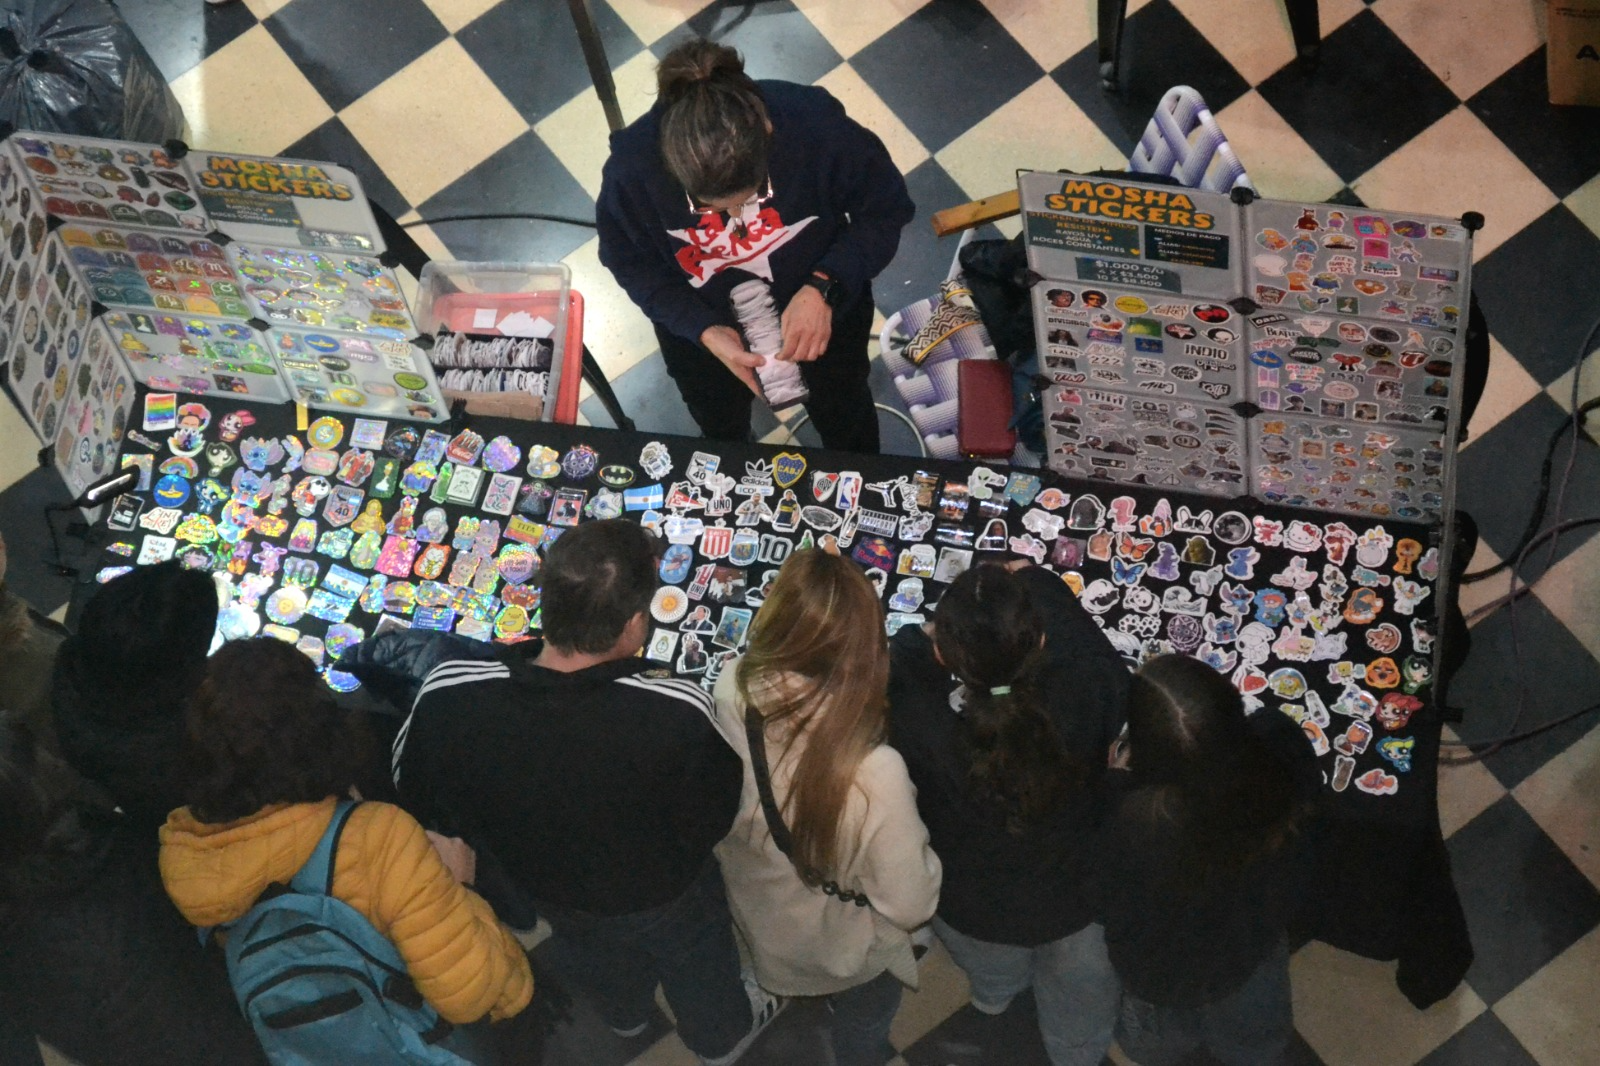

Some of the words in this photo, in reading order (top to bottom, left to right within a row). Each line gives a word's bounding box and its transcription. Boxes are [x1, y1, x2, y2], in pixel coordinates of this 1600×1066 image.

[211, 158, 328, 181] MOSHA
[201, 171, 353, 200] STICKERS
[1065, 180, 1192, 208] MOSHA
[1047, 194, 1214, 228] STICKERS
[1055, 229, 1086, 237] RAYOS
[1065, 235, 1091, 243] AGUA
[1154, 228, 1185, 236] MEDIOS
[1198, 233, 1222, 241] PAGO
[1033, 236, 1064, 245] ROCES
[1066, 239, 1125, 253] CONSTANTES
[1095, 260, 1139, 272] $1.000
[1142, 263, 1164, 275] c/u
[1119, 270, 1159, 281] $3.500
[1122, 276, 1162, 287] $8.500
[1256, 313, 1287, 324] oasis
[1185, 344, 1228, 361] INDIO
[693, 470, 706, 480] 40
[778, 465, 801, 476] CABJ
[742, 477, 769, 486] adidas
[713, 499, 731, 510] UNO
[335, 506, 350, 517] 40
[517, 521, 536, 533] TITA
[762, 537, 788, 562] 10
[858, 549, 875, 562] Red
[690, 583, 706, 595] UNO
